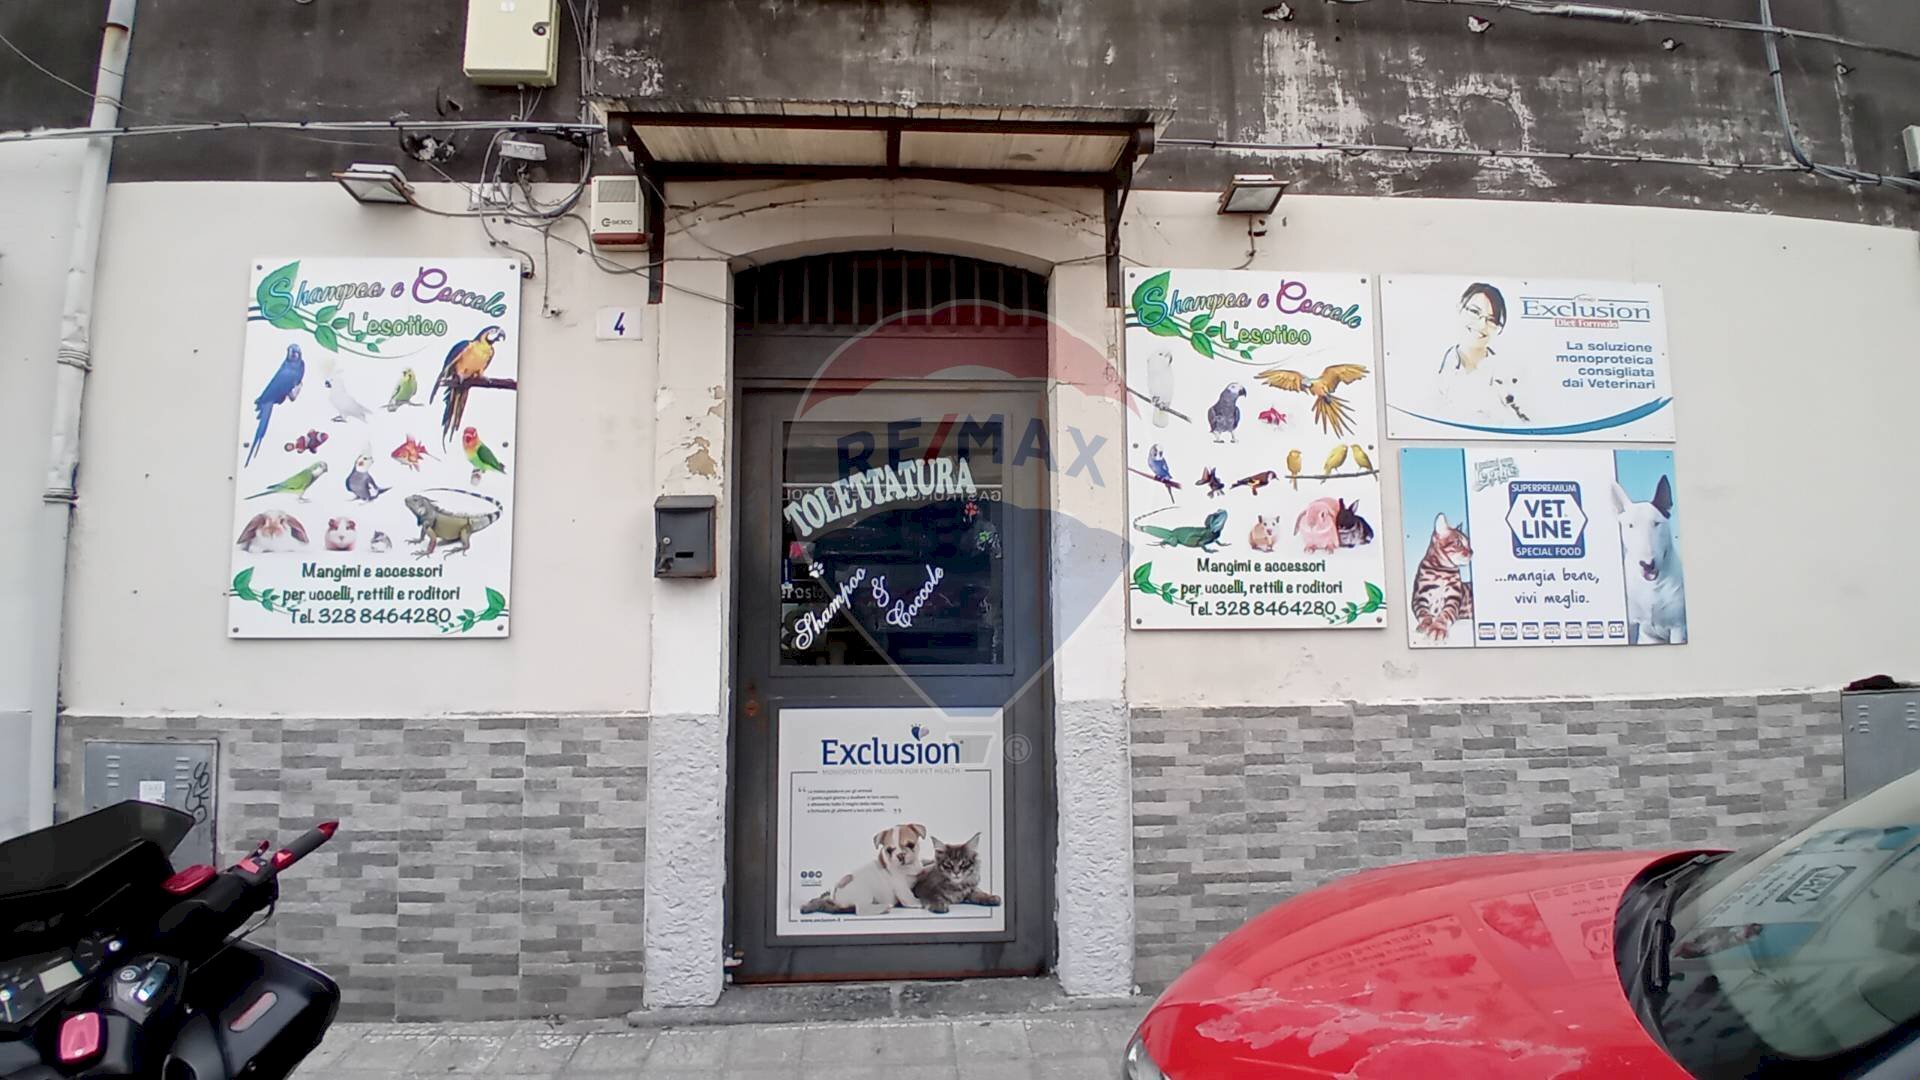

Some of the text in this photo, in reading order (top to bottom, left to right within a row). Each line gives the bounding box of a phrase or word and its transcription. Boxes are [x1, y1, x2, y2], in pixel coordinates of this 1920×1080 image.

[261, 275, 385, 321] Shampoo
[411, 266, 508, 318] Coccole
[1138, 285, 1252, 328] Shampoo
[1276, 279, 1362, 329] Coccole
[1522, 300, 1651, 319] Exclusion
[347, 311, 448, 337] L'esotico
[613, 311, 626, 336] 4
[1219, 320, 1312, 346] L'esotico
[1566, 340, 1653, 353] La soluzione
[1555, 354, 1654, 365] monoproteica
[1577, 366, 1655, 379] consigliata
[1561, 378, 1656, 390] dai Veterinari
[783, 456, 977, 537] TOLETTATURA
[1511, 483, 1577, 493] SUPERPREMIUM
[1523, 499, 1566, 519] VET
[1521, 519, 1573, 539] LINE
[1516, 547, 1582, 557] SPECIAL FOOD
[301, 563, 443, 582] Mangimi e accessori
[1197, 558, 1326, 576] Mangimi e accessori
[1562, 567, 1600, 584] bene,
[282, 586, 461, 605] per uccelli, rettili e roditori
[1180, 579, 1343, 599] per uccelli, rettili e roditori
[1514, 588, 1590, 609] vivi meglio.
[290, 607, 451, 624] Tel. 328 8464280
[794, 564, 944, 650] Shampoo & Coccole
[1189, 600, 1336, 616] Tel. 328 8464280
[821, 736, 961, 765] Exclusion
